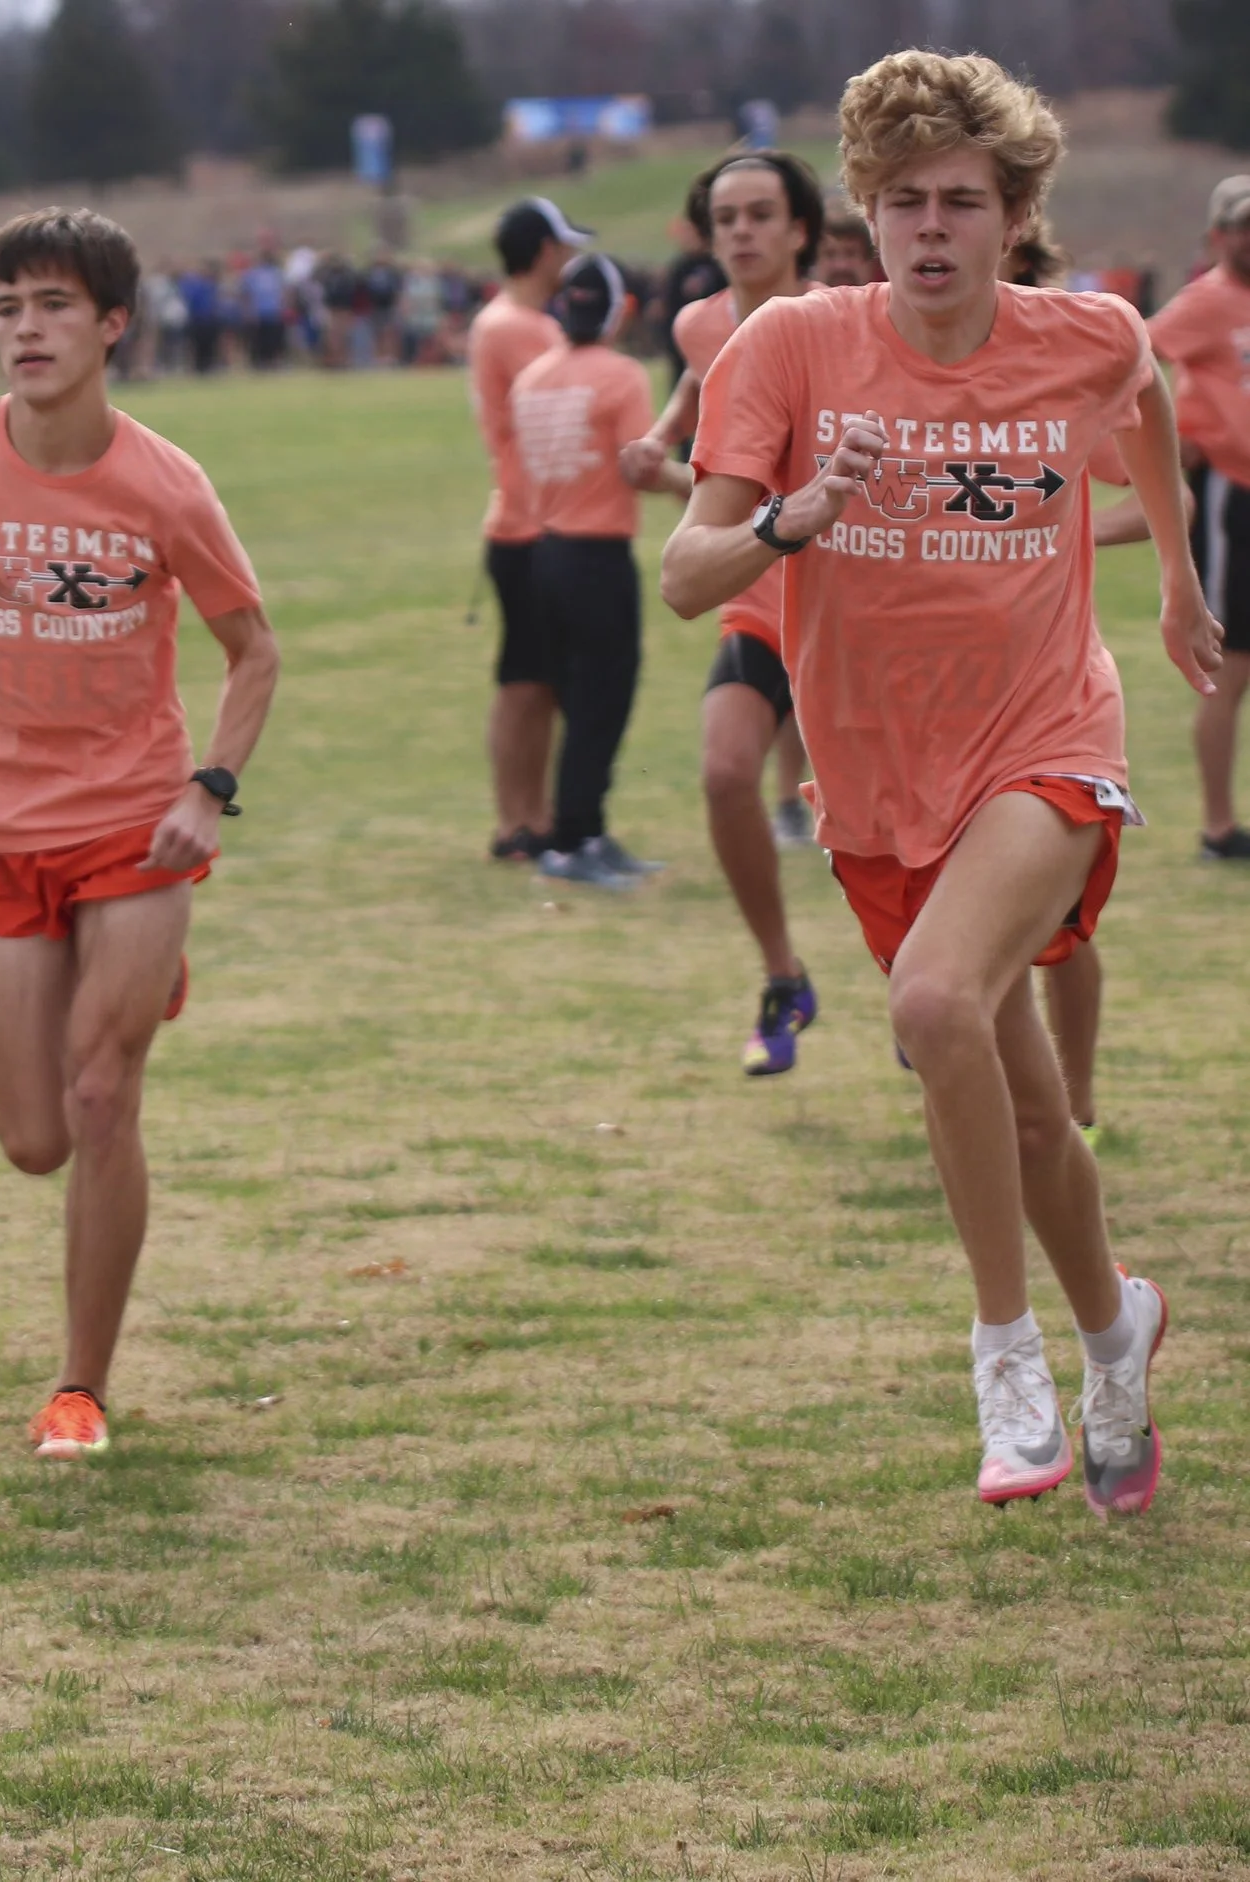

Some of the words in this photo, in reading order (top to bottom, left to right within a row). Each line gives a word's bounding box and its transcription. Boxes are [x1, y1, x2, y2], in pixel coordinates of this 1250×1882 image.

[816, 409, 1068, 453] STESMEN
[921, 524, 1060, 561] COUNTRY
[33, 601, 147, 641] COUNTRY
